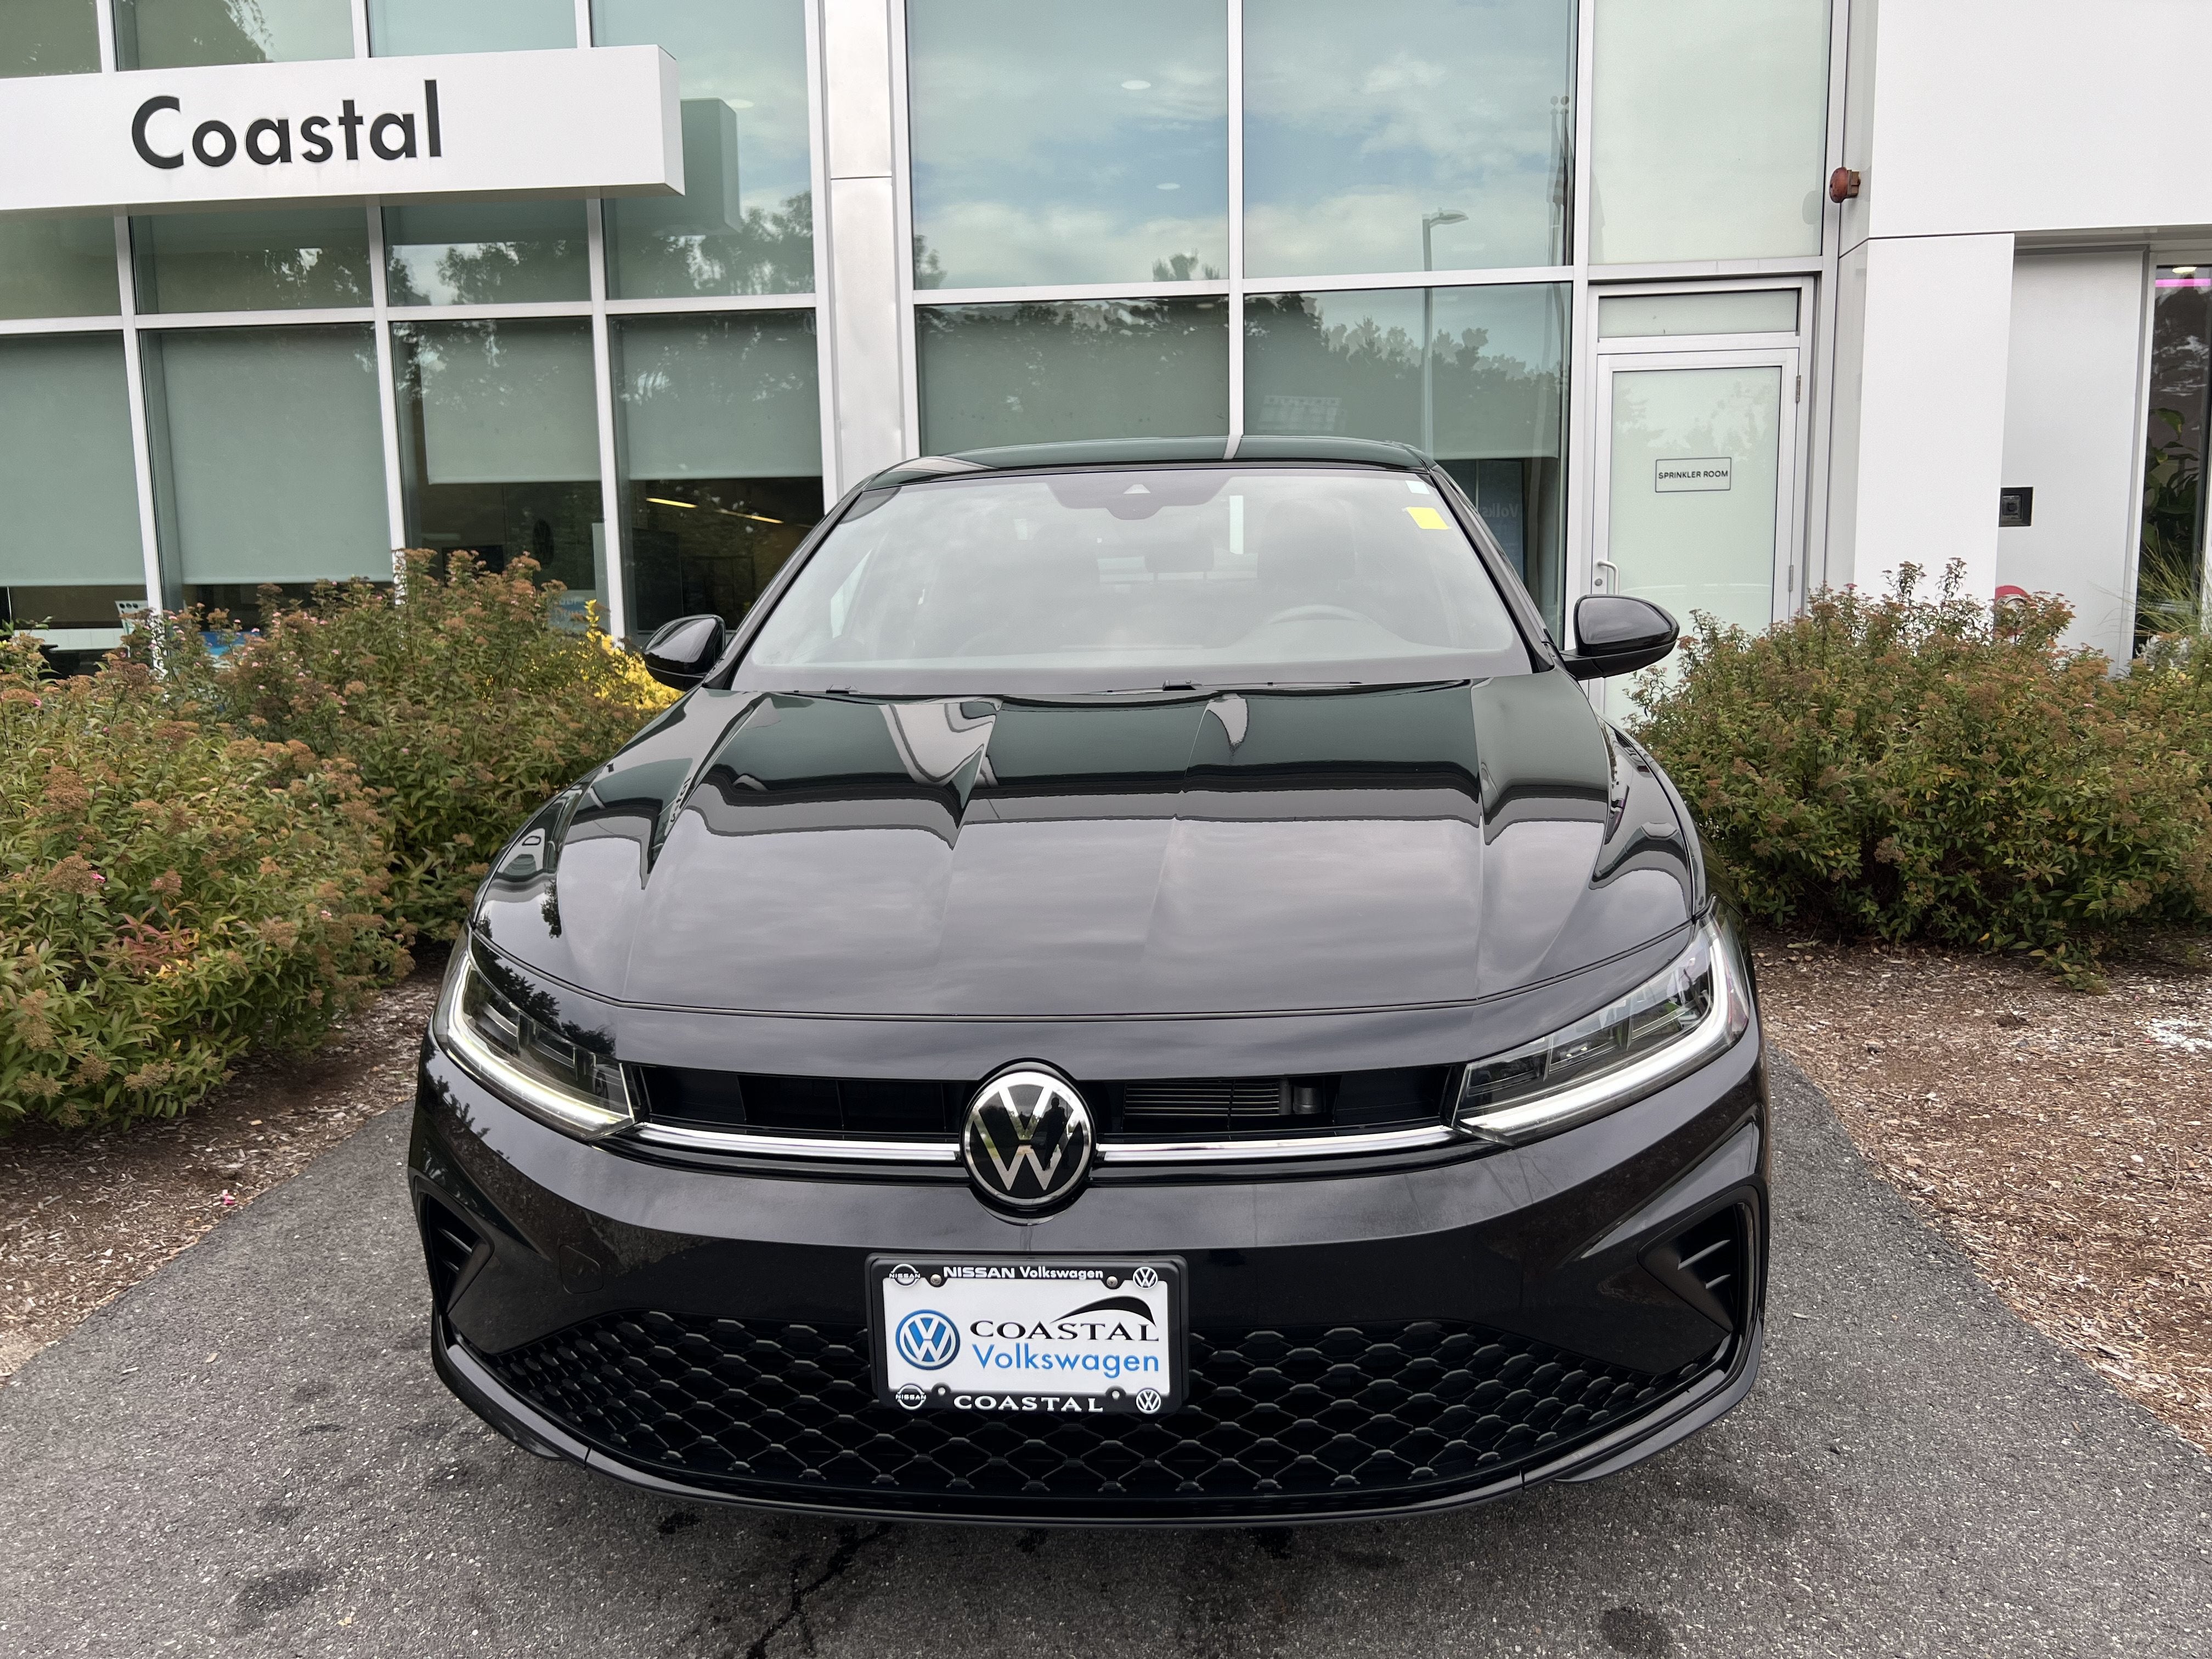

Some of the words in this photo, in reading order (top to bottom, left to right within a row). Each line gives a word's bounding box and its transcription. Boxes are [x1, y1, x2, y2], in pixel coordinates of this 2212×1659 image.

[132, 79, 442, 169] Coastal
[943, 1266, 1015, 1279] NISSAN
[1019, 1266, 1103, 1280] Volkswagen
[970, 1319, 1159, 1341] COASTAL
[972, 1342, 1159, 1378] Volkswagen
[953, 1395, 1103, 1412] COASTAL
